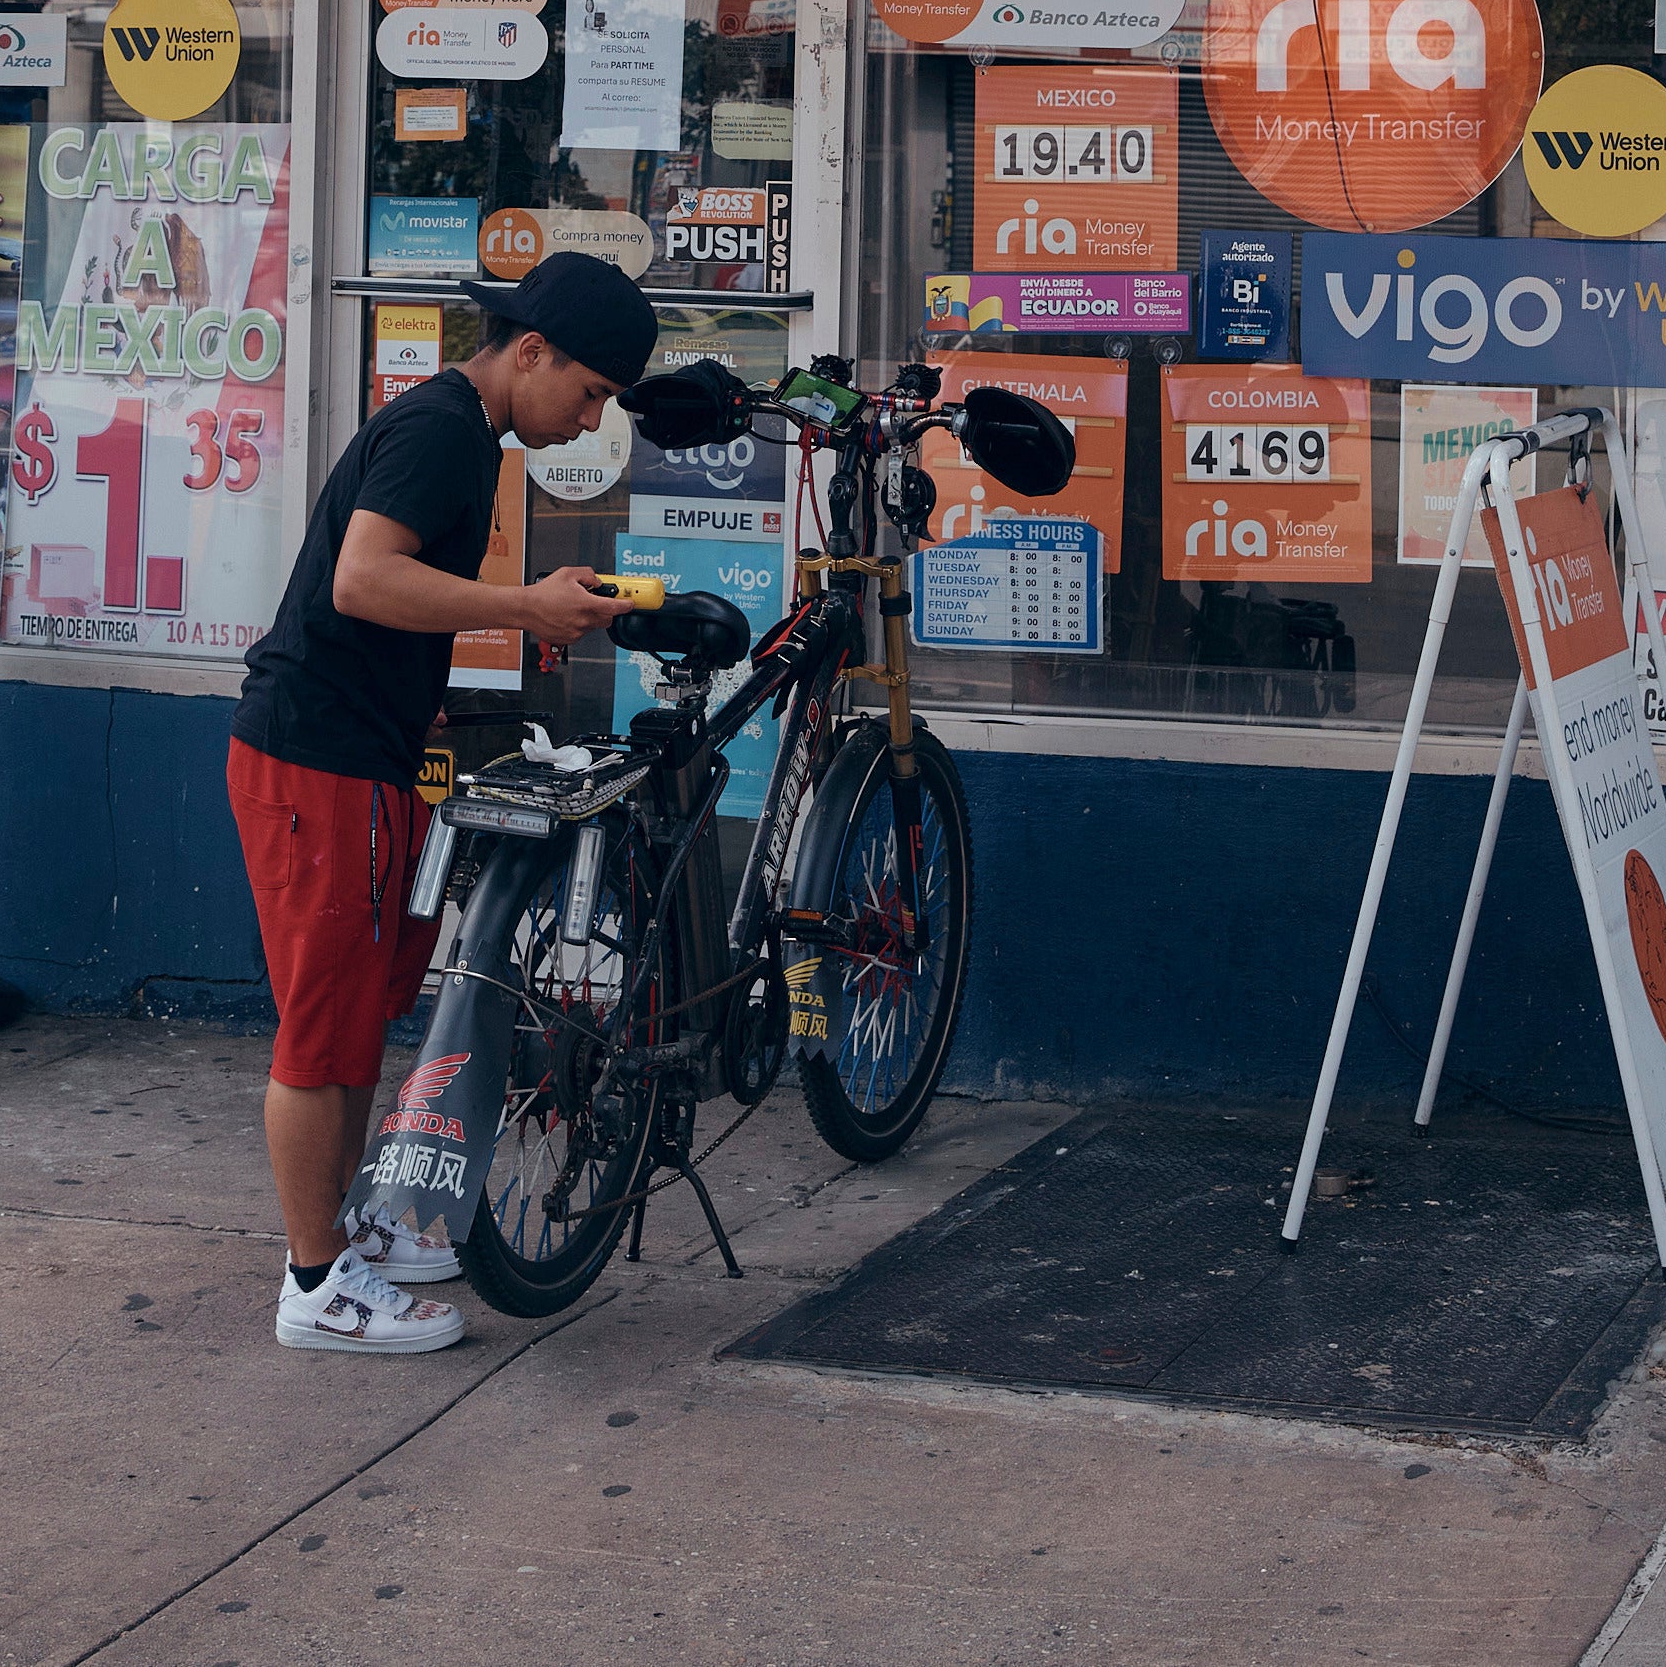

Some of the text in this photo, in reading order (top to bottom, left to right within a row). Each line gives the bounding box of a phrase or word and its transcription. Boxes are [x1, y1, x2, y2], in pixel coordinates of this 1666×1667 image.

[600, 44, 646, 55] PERSONAL
[2, 53, 53, 69] Azteca
[590, 60, 655, 71] Para PART TIME
[1036, 89, 1117, 108] MEXICO
[1256, 110, 1487, 145] Money Transfer
[1001, 129, 1146, 175] 19.40
[39, 122, 275, 206] CARGA
[1599, 151, 1661, 173] Union
[408, 215, 469, 230] movistar
[997, 199, 1077, 255] ria
[1085, 218, 1146, 237] Money
[552, 227, 644, 245] Compra money
[667, 226, 764, 260] PUSH
[771, 194, 789, 293] PUSH
[122, 216, 175, 289] A
[1084, 238, 1155, 257] Transfer
[1133, 278, 1166, 289] Banco
[1133, 287, 1183, 299] del Barrio
[1019, 299, 1120, 317] ECUADOR
[1325, 248, 1562, 364] vigo
[1581, 280, 1625, 318] by
[17, 301, 282, 380] MEXICO
[1207, 389, 1320, 411] COLOMBIA
[1191, 430, 1325, 478] 4169
[545, 467, 604, 484] ABIERTO
[565, 484, 584, 494] OPEN
[663, 508, 754, 531] EMPUJE
[928, 549, 979, 560] MONDAY
[928, 562, 981, 573] TUESDAY
[928, 575, 1000, 586] WEDNESDAY
[928, 588, 990, 599] THURSDAY
[928, 600, 969, 611] FRIDAY
[928, 613, 988, 624] SATURDAY
[928, 625, 975, 636] SUNDAY
[380, 1111, 466, 1142] HONDA
[362, 1142, 467, 1199] 一路顺风
